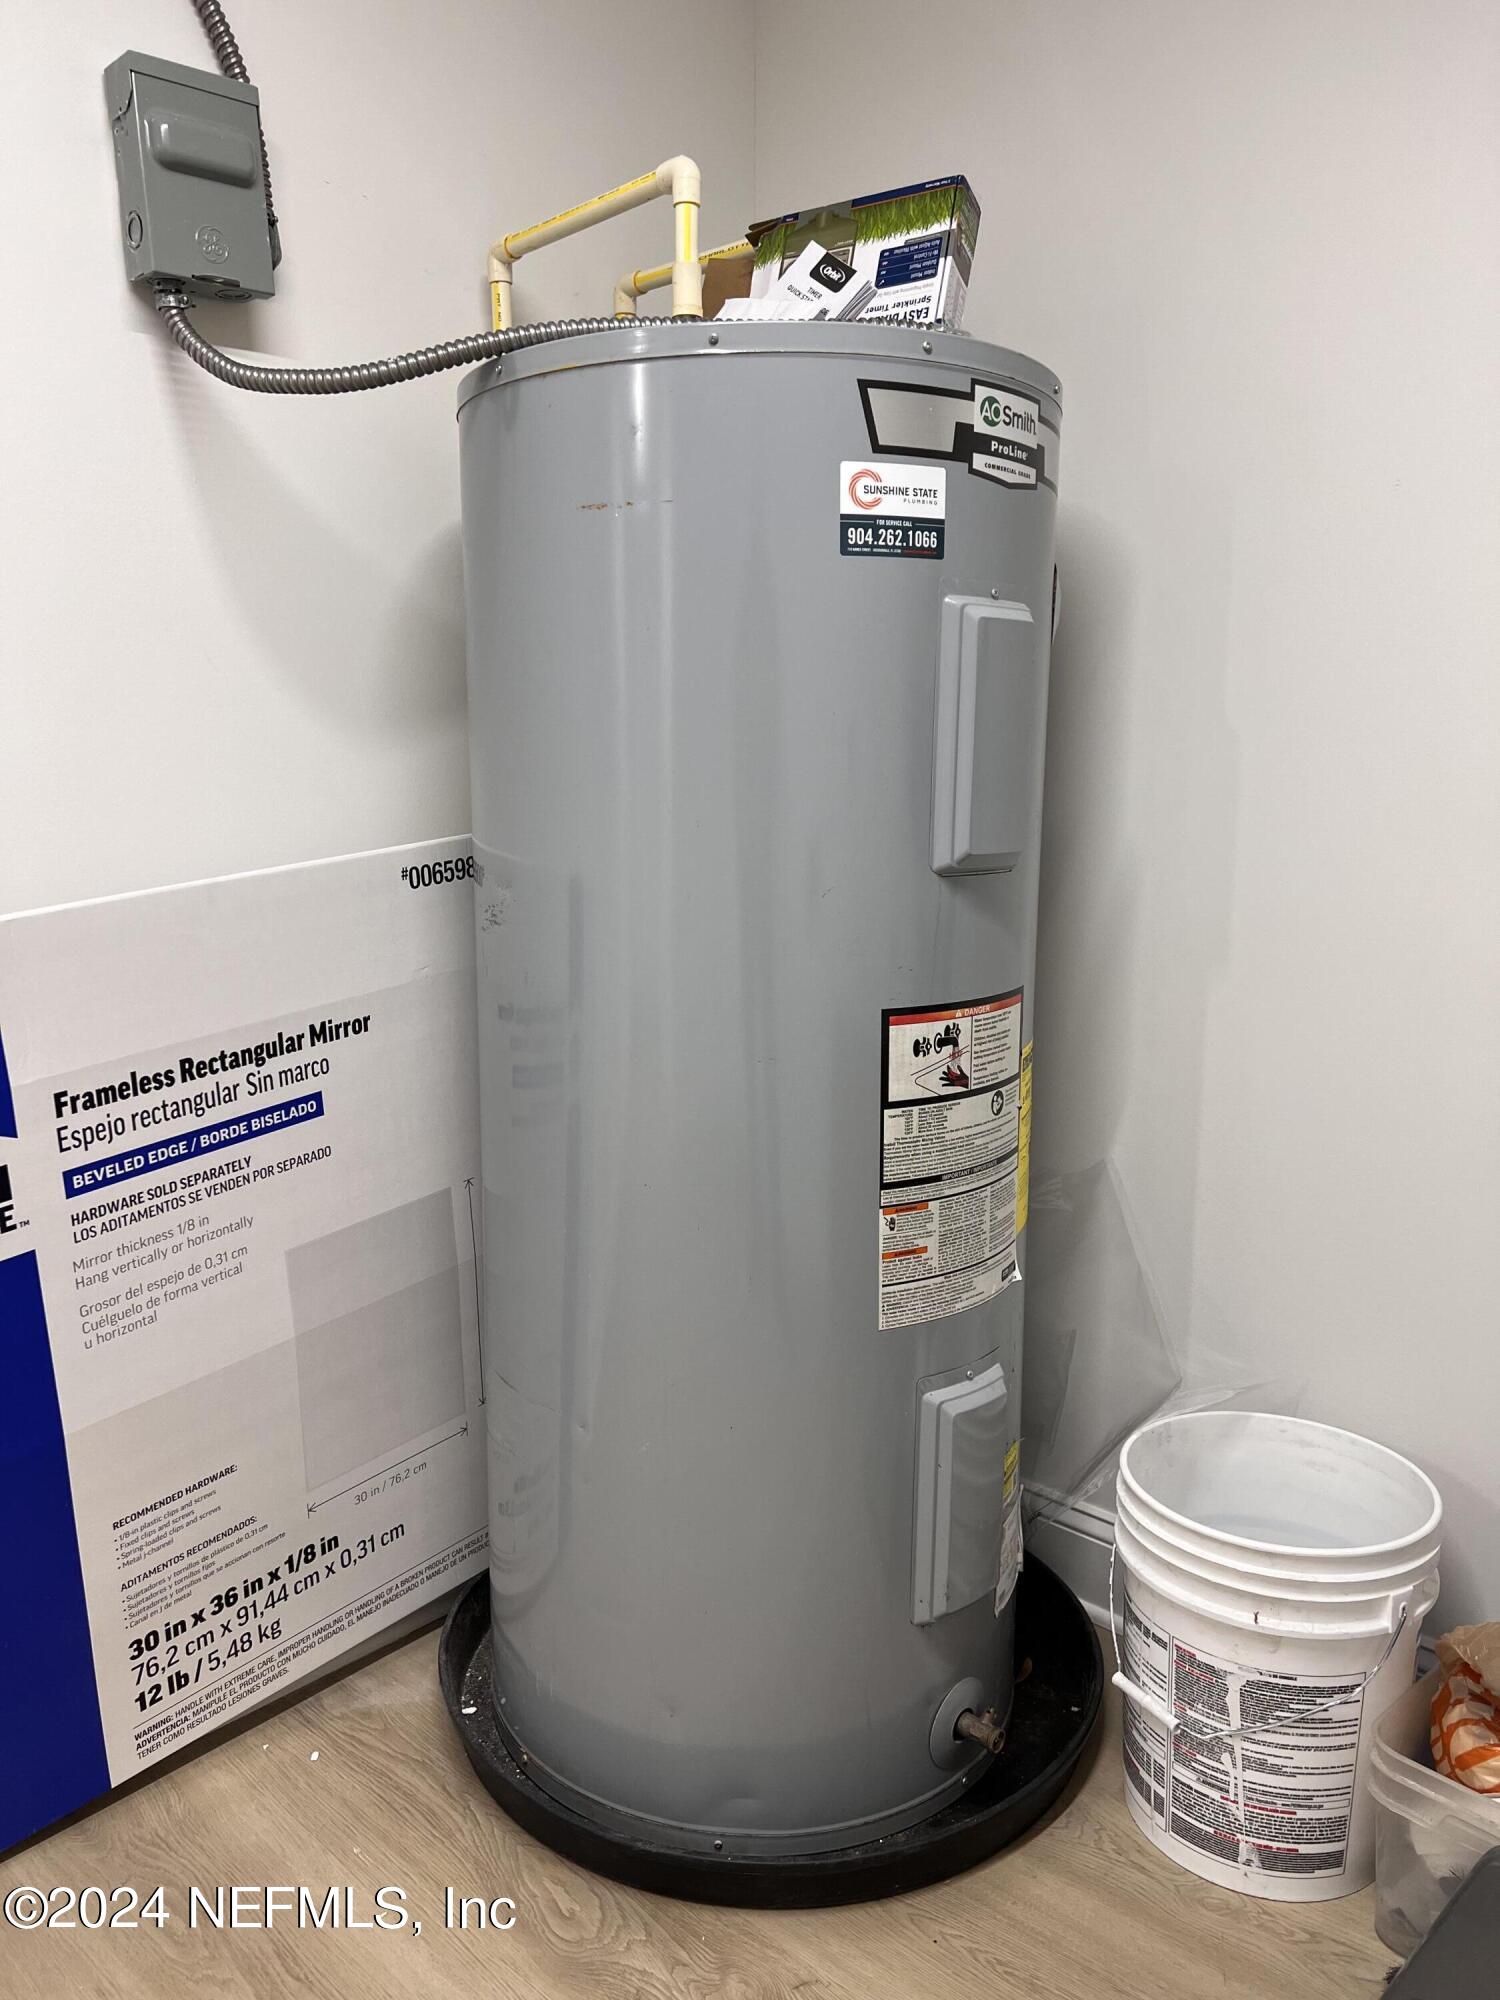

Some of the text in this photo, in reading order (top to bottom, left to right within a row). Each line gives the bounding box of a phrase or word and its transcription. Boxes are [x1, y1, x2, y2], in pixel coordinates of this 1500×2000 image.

[824, 266, 841, 281] Orbit
[864, 295, 932, 314] Sprinkler Timer
[902, 306, 930, 321] EASY
[984, 462, 1017, 475] COMMERCIAL
[991, 440, 1027, 461] ProLine
[863, 484, 938, 499] SUNSHINE STATE
[903, 497, 938, 506] PLUMBING
[847, 527, 938, 548] 904.262.1066
[964, 1004, 991, 1017] DANGER
[53, 1015, 371, 1118] Frameless Rectangular Mirror
[56, 1058, 330, 1153] Espejo rectangular Sin marco
[72, 1100, 317, 1189] BEVELED EDGE / BORDE BISELADO
[70, 1191, 146, 1227] HARDWARE
[147, 1180, 178, 1201] SOLD
[179, 1155, 252, 1190] SEPARATELY
[73, 1145, 332, 1244] LOS ADITAMENTOS SE VENDEN POR SEPARADO
[72, 1215, 210, 1273] Mirror thickness 1/8 in
[75, 1215, 254, 1290] Hang vertically or horizontally
[79, 1293, 122, 1318] Grosor
[125, 1283, 143, 1301] del
[147, 1271, 185, 1293] espejo
[187, 1262, 202, 1277] de
[231, 1245, 248, 1260] cm
[82, 1262, 243, 1335] Cuélguelo de forma vertical
[84, 1310, 158, 1350] u horizontal
[112, 1463, 238, 1531] RECOMMENDED HARDWARE:
[354, 1461, 427, 1506] 30 in / 76,2 cm
[121, 1515, 258, 1592] ADITAMENTOS RECOMENDADOS:
[128, 1535, 340, 1661] 30 in x 36 in x 1/8 in
[131, 1523, 405, 1686] 76,2 cm x 91,44 cm x 0,31 cm
[134, 1714, 174, 1742] WARNING:
[175, 1696, 204, 1718] HANDLE
[204, 1684, 223, 1701] WITH
[224, 1665, 257, 1690] EXTREME
[278, 1635, 311, 1658] IMPROPER
[311, 1615, 344, 1639] HANDLING
[344, 1609, 354, 1619] OR
[354, 1592, 385, 1613] HANDLING
[386, 1586, 395, 1595] OF
[400, 1570, 424, 1587] BROKEN
[425, 1554, 451, 1573] PRODUCT
[451, 1545, 464, 1558] CAN
[463, 1536, 483, 1550] RESULT
[134, 1618, 282, 1713] 12 lb / 5,48 kg
[136, 1714, 191, 1752] ADVERTENCIA:
[192, 1691, 228, 1718] MANIPULE
[229, 1689, 238, 1697] EL
[239, 1665, 276, 1690] PRODUCTO
[276, 1655, 291, 1668] CON
[292, 1641, 316, 1660] MUCHO
[347, 1619, 356, 1627] EL
[356, 1603, 382, 1621] MANEJO
[382, 1580, 419, 1607] INADECUADO
[425, 1564, 449, 1581] MANEJO
[450, 1559, 458, 1568] DE
[459, 1554, 467, 1563] UN
[137, 1741, 162, 1760] TENER
[163, 1727, 186, 1745] COMO
[187, 1704, 227, 1732] RESULTADO
[228, 1683, 261, 1707] LESIONES
